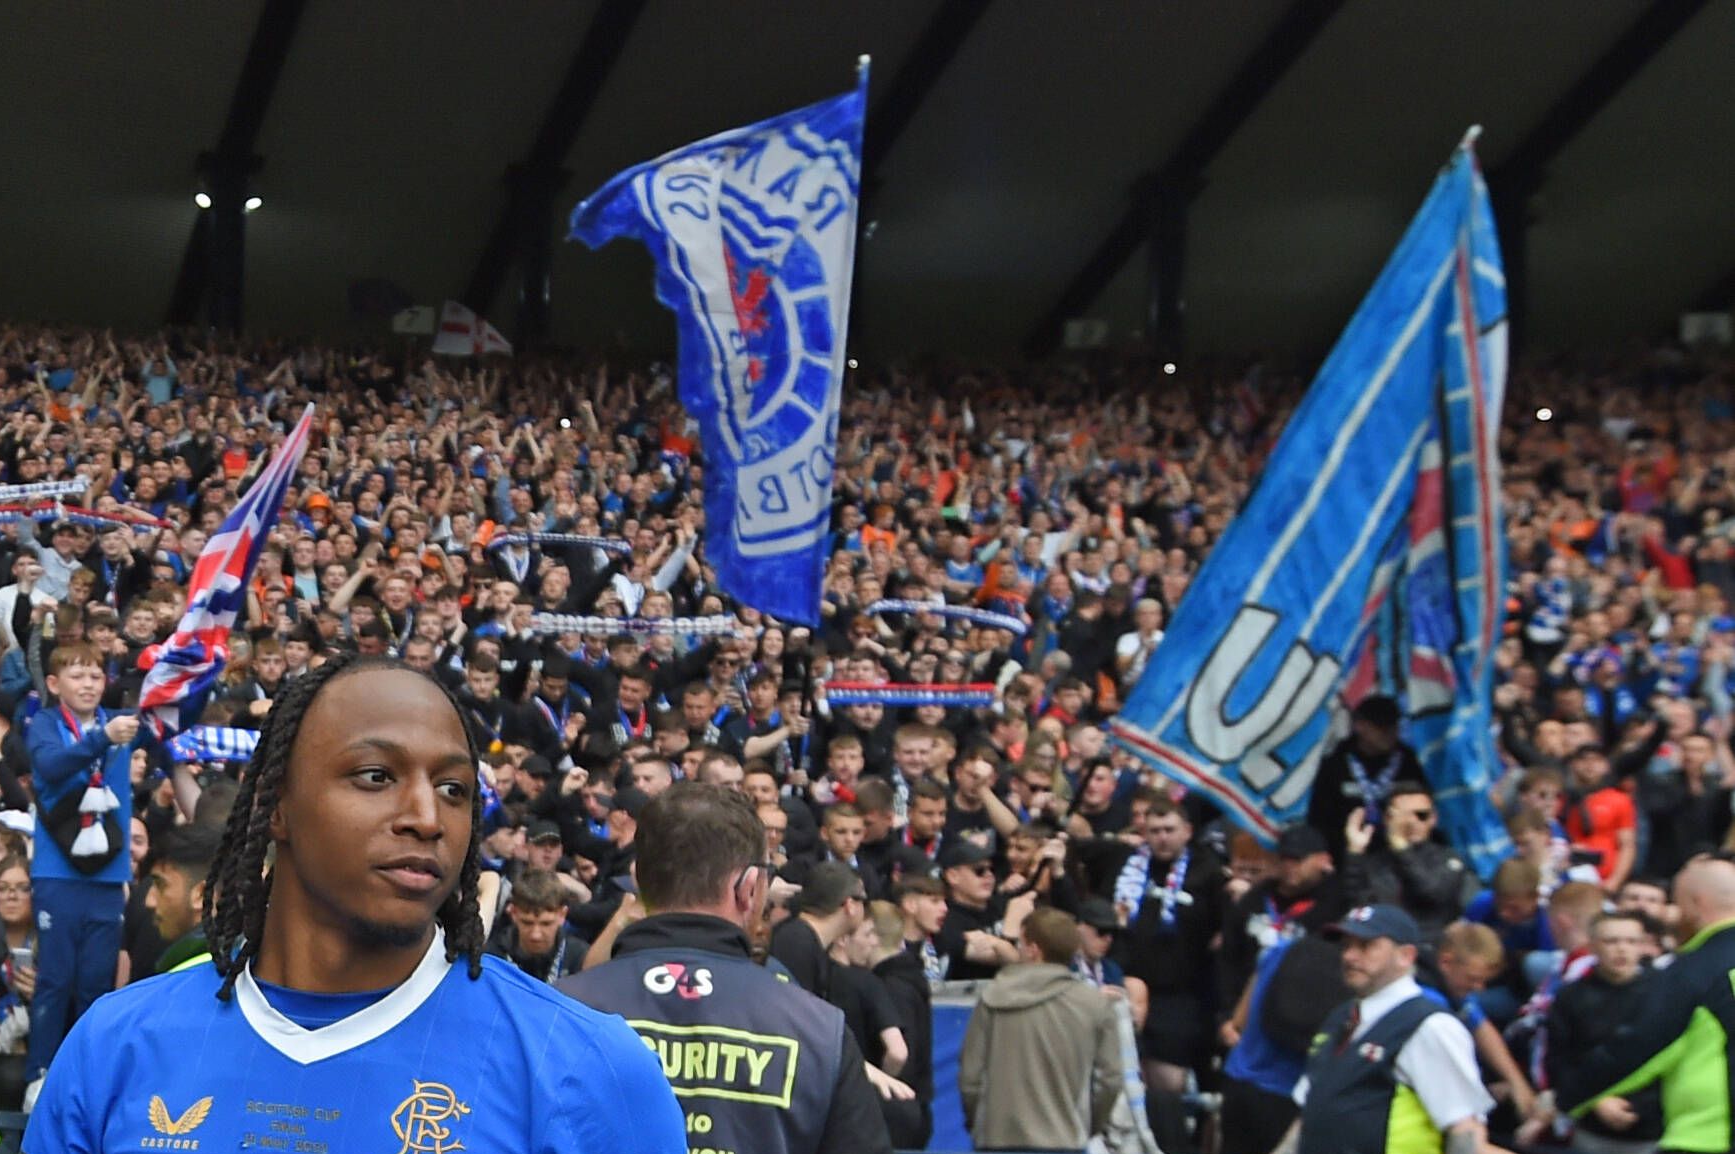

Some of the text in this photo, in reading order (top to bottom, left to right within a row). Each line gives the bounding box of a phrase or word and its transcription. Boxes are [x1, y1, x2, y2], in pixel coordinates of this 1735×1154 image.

[643, 962, 713, 1000] G4S
[642, 1036, 773, 1086] URITY
[140, 1136, 201, 1151] CASTORE
